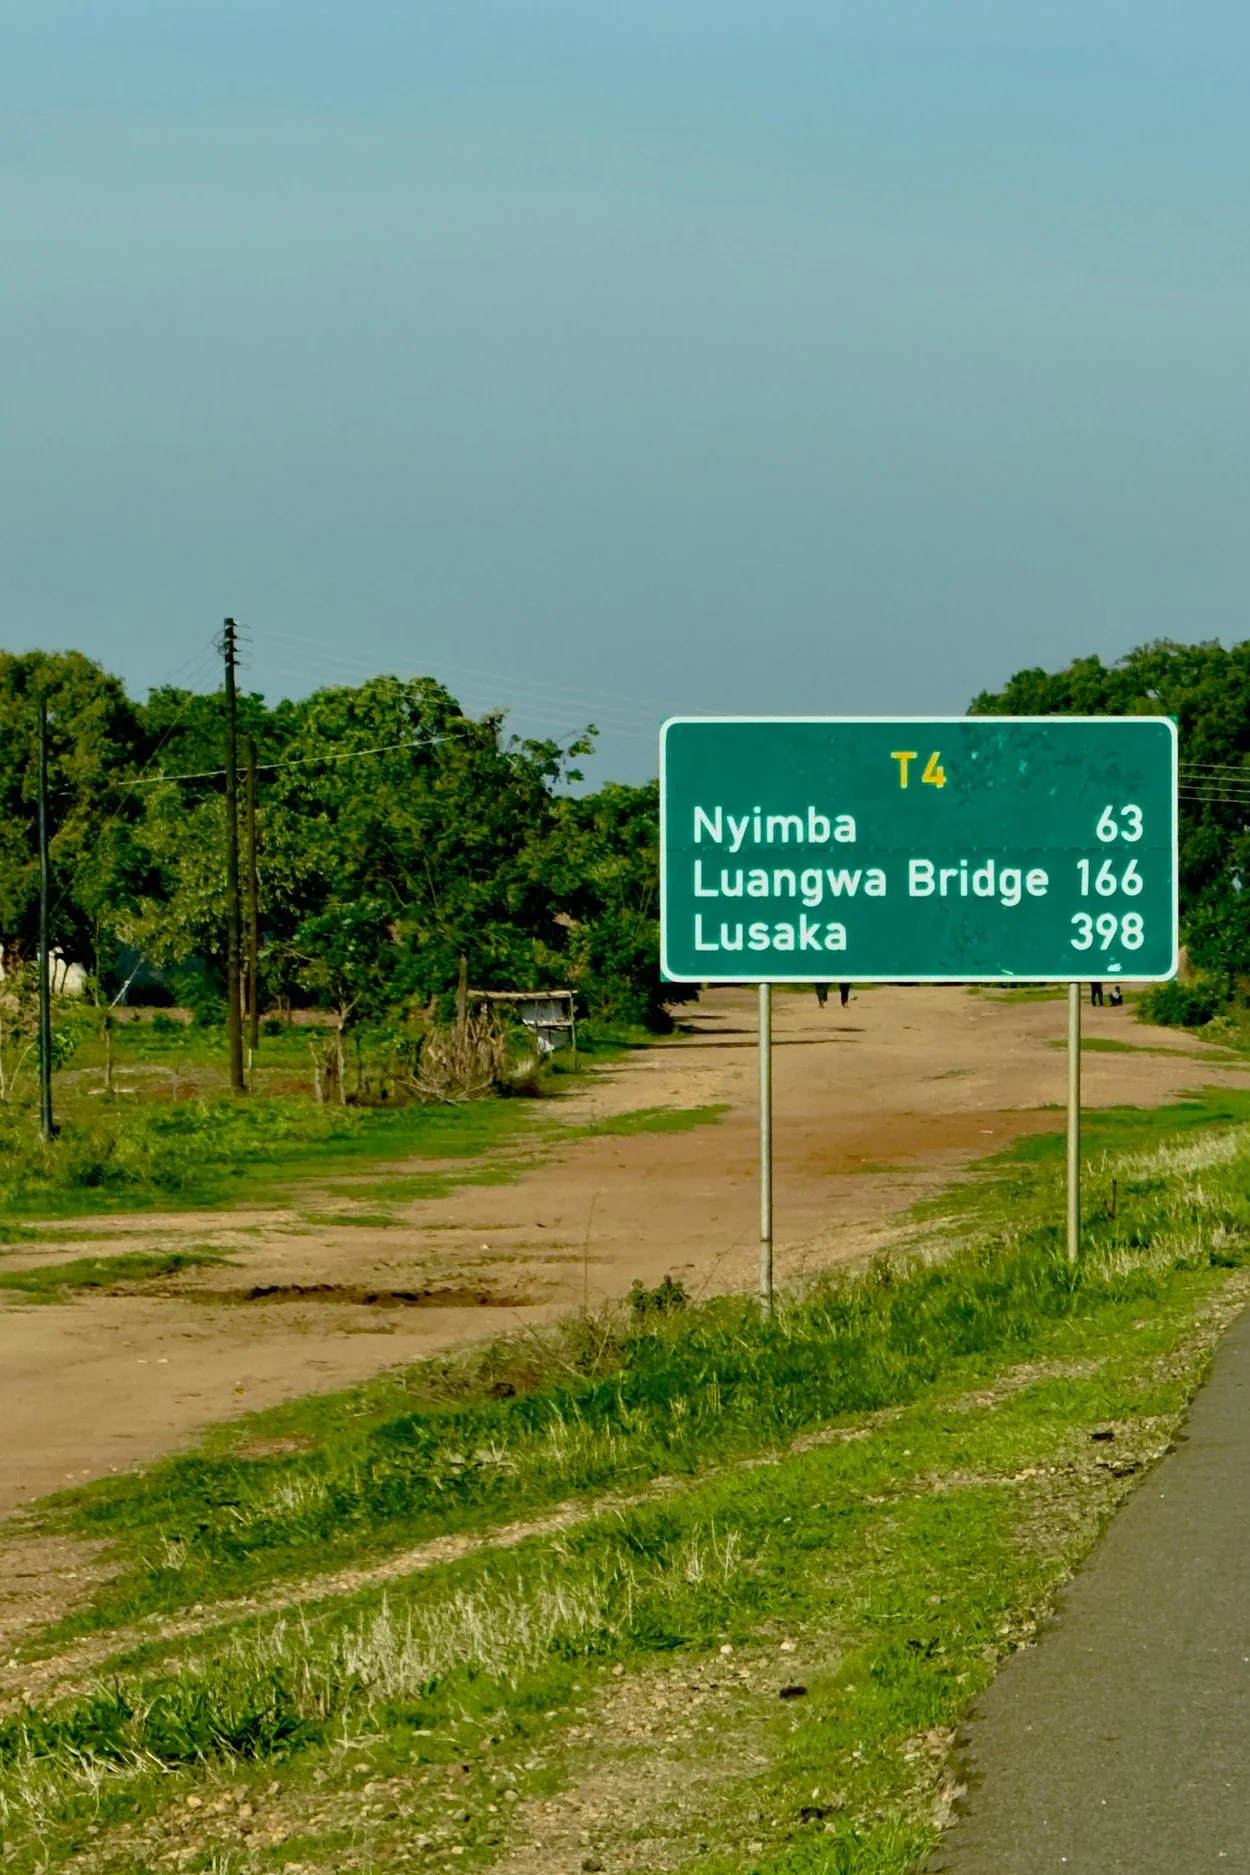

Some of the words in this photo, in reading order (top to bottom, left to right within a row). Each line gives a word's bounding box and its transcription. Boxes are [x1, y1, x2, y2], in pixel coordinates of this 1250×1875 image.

[890, 751, 947, 789] T4
[694, 806, 857, 853] Nyimba
[1095, 804, 1144, 843] 63
[694, 859, 888, 907] Luangwa
[908, 858, 1049, 907] Bridge
[1076, 858, 1144, 897] 166
[694, 913, 848, 951] Lusaka
[1070, 912, 1145, 951] 398
